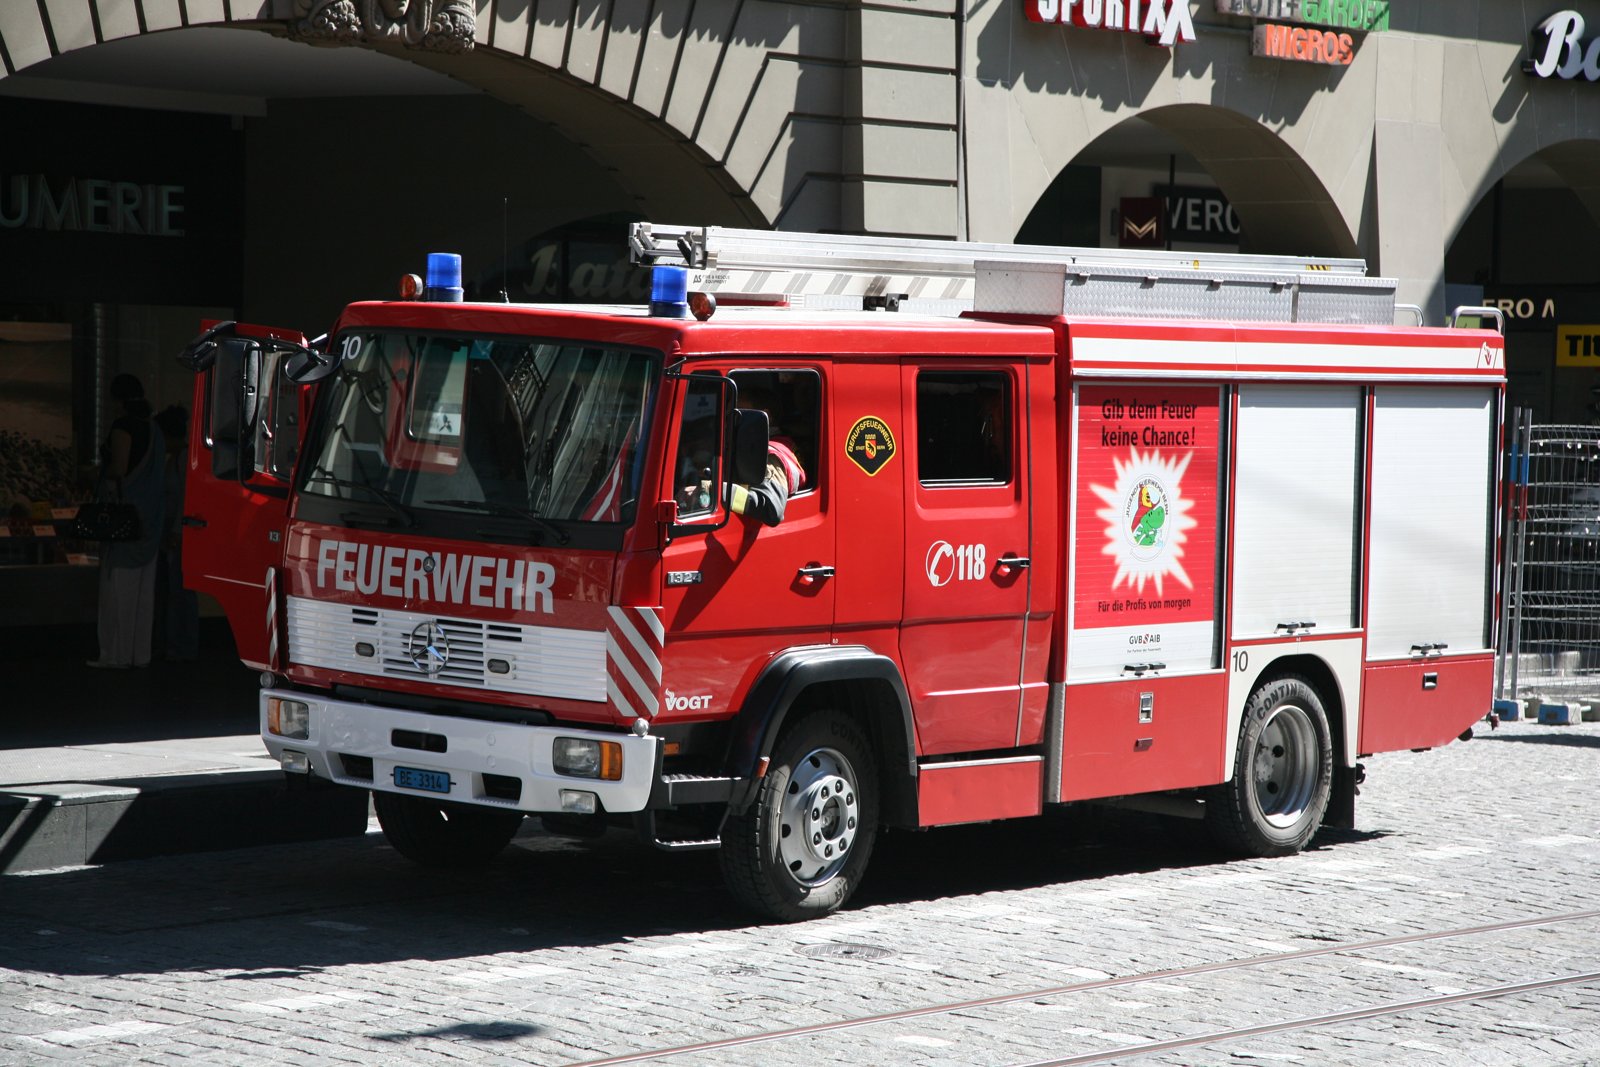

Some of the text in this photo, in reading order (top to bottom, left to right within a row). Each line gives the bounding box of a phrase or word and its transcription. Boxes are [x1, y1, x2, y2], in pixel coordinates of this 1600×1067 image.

[1302, 0, 1390, 32] GARDEN
[1266, 24, 1353, 65] MIGROS
[341, 335, 362, 361] 10
[1102, 399, 1197, 419] Gib dem Feuer
[1102, 425, 1138, 446] keine
[956, 543, 986, 580] 118
[317, 539, 556, 614] FEUERWEHR
[1098, 598, 1191, 612] Für die Profis von morgen
[1232, 651, 1249, 673] 10
[665, 688, 713, 711] VOGT
[418, 773, 442, 788] 3314
